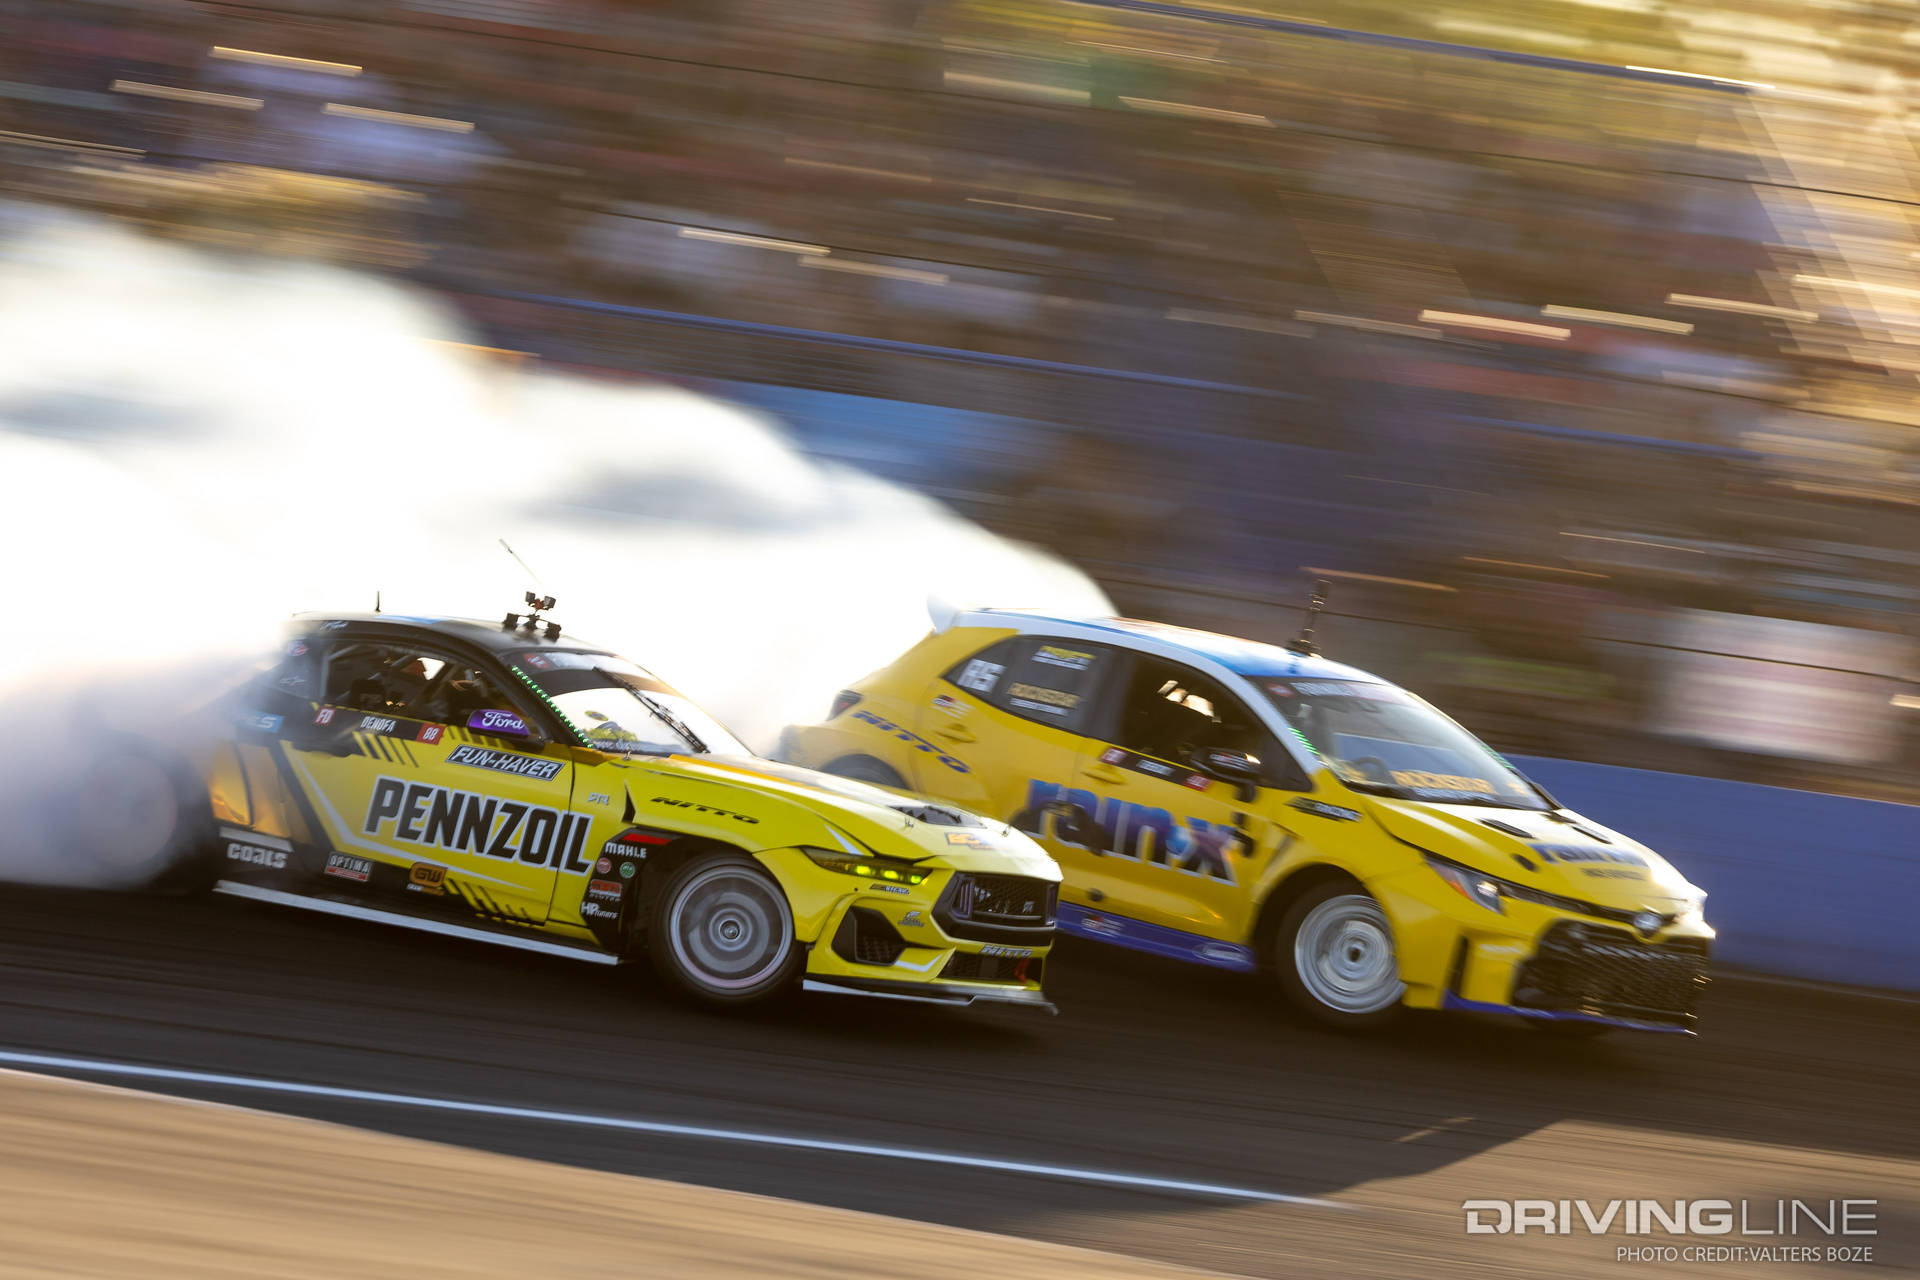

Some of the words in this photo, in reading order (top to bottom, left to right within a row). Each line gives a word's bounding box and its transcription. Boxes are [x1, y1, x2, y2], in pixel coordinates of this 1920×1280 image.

[482, 711, 525, 730] Ford
[422, 727, 439, 741] 88
[852, 709, 972, 774] NITTO
[450, 747, 560, 778] FUN-HAVER
[650, 796, 760, 825] NITTO
[363, 774, 594, 877] PENNZOIL
[605, 841, 647, 859] MAHLE
[330, 854, 371, 874] OPTIMA
